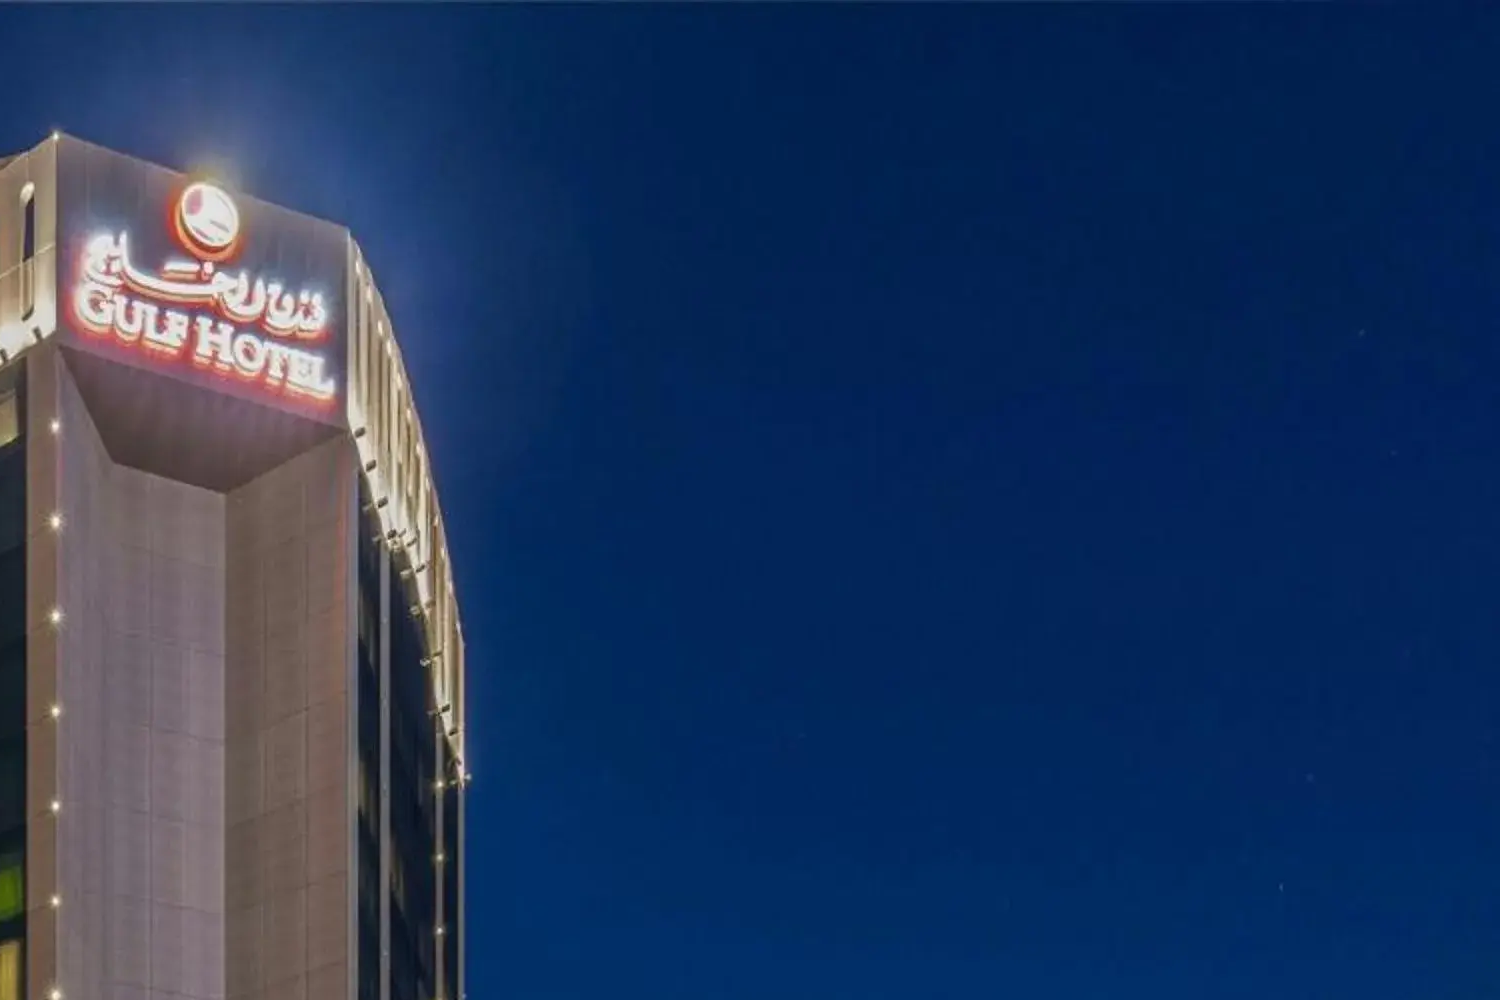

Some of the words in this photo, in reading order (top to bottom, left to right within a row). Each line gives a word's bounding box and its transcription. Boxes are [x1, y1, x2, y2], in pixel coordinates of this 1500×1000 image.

[83, 230, 265, 322] الخليج
[265, 281, 328, 334] فندق
[76, 282, 190, 349] GULF
[194, 315, 337, 399] HOTEL
